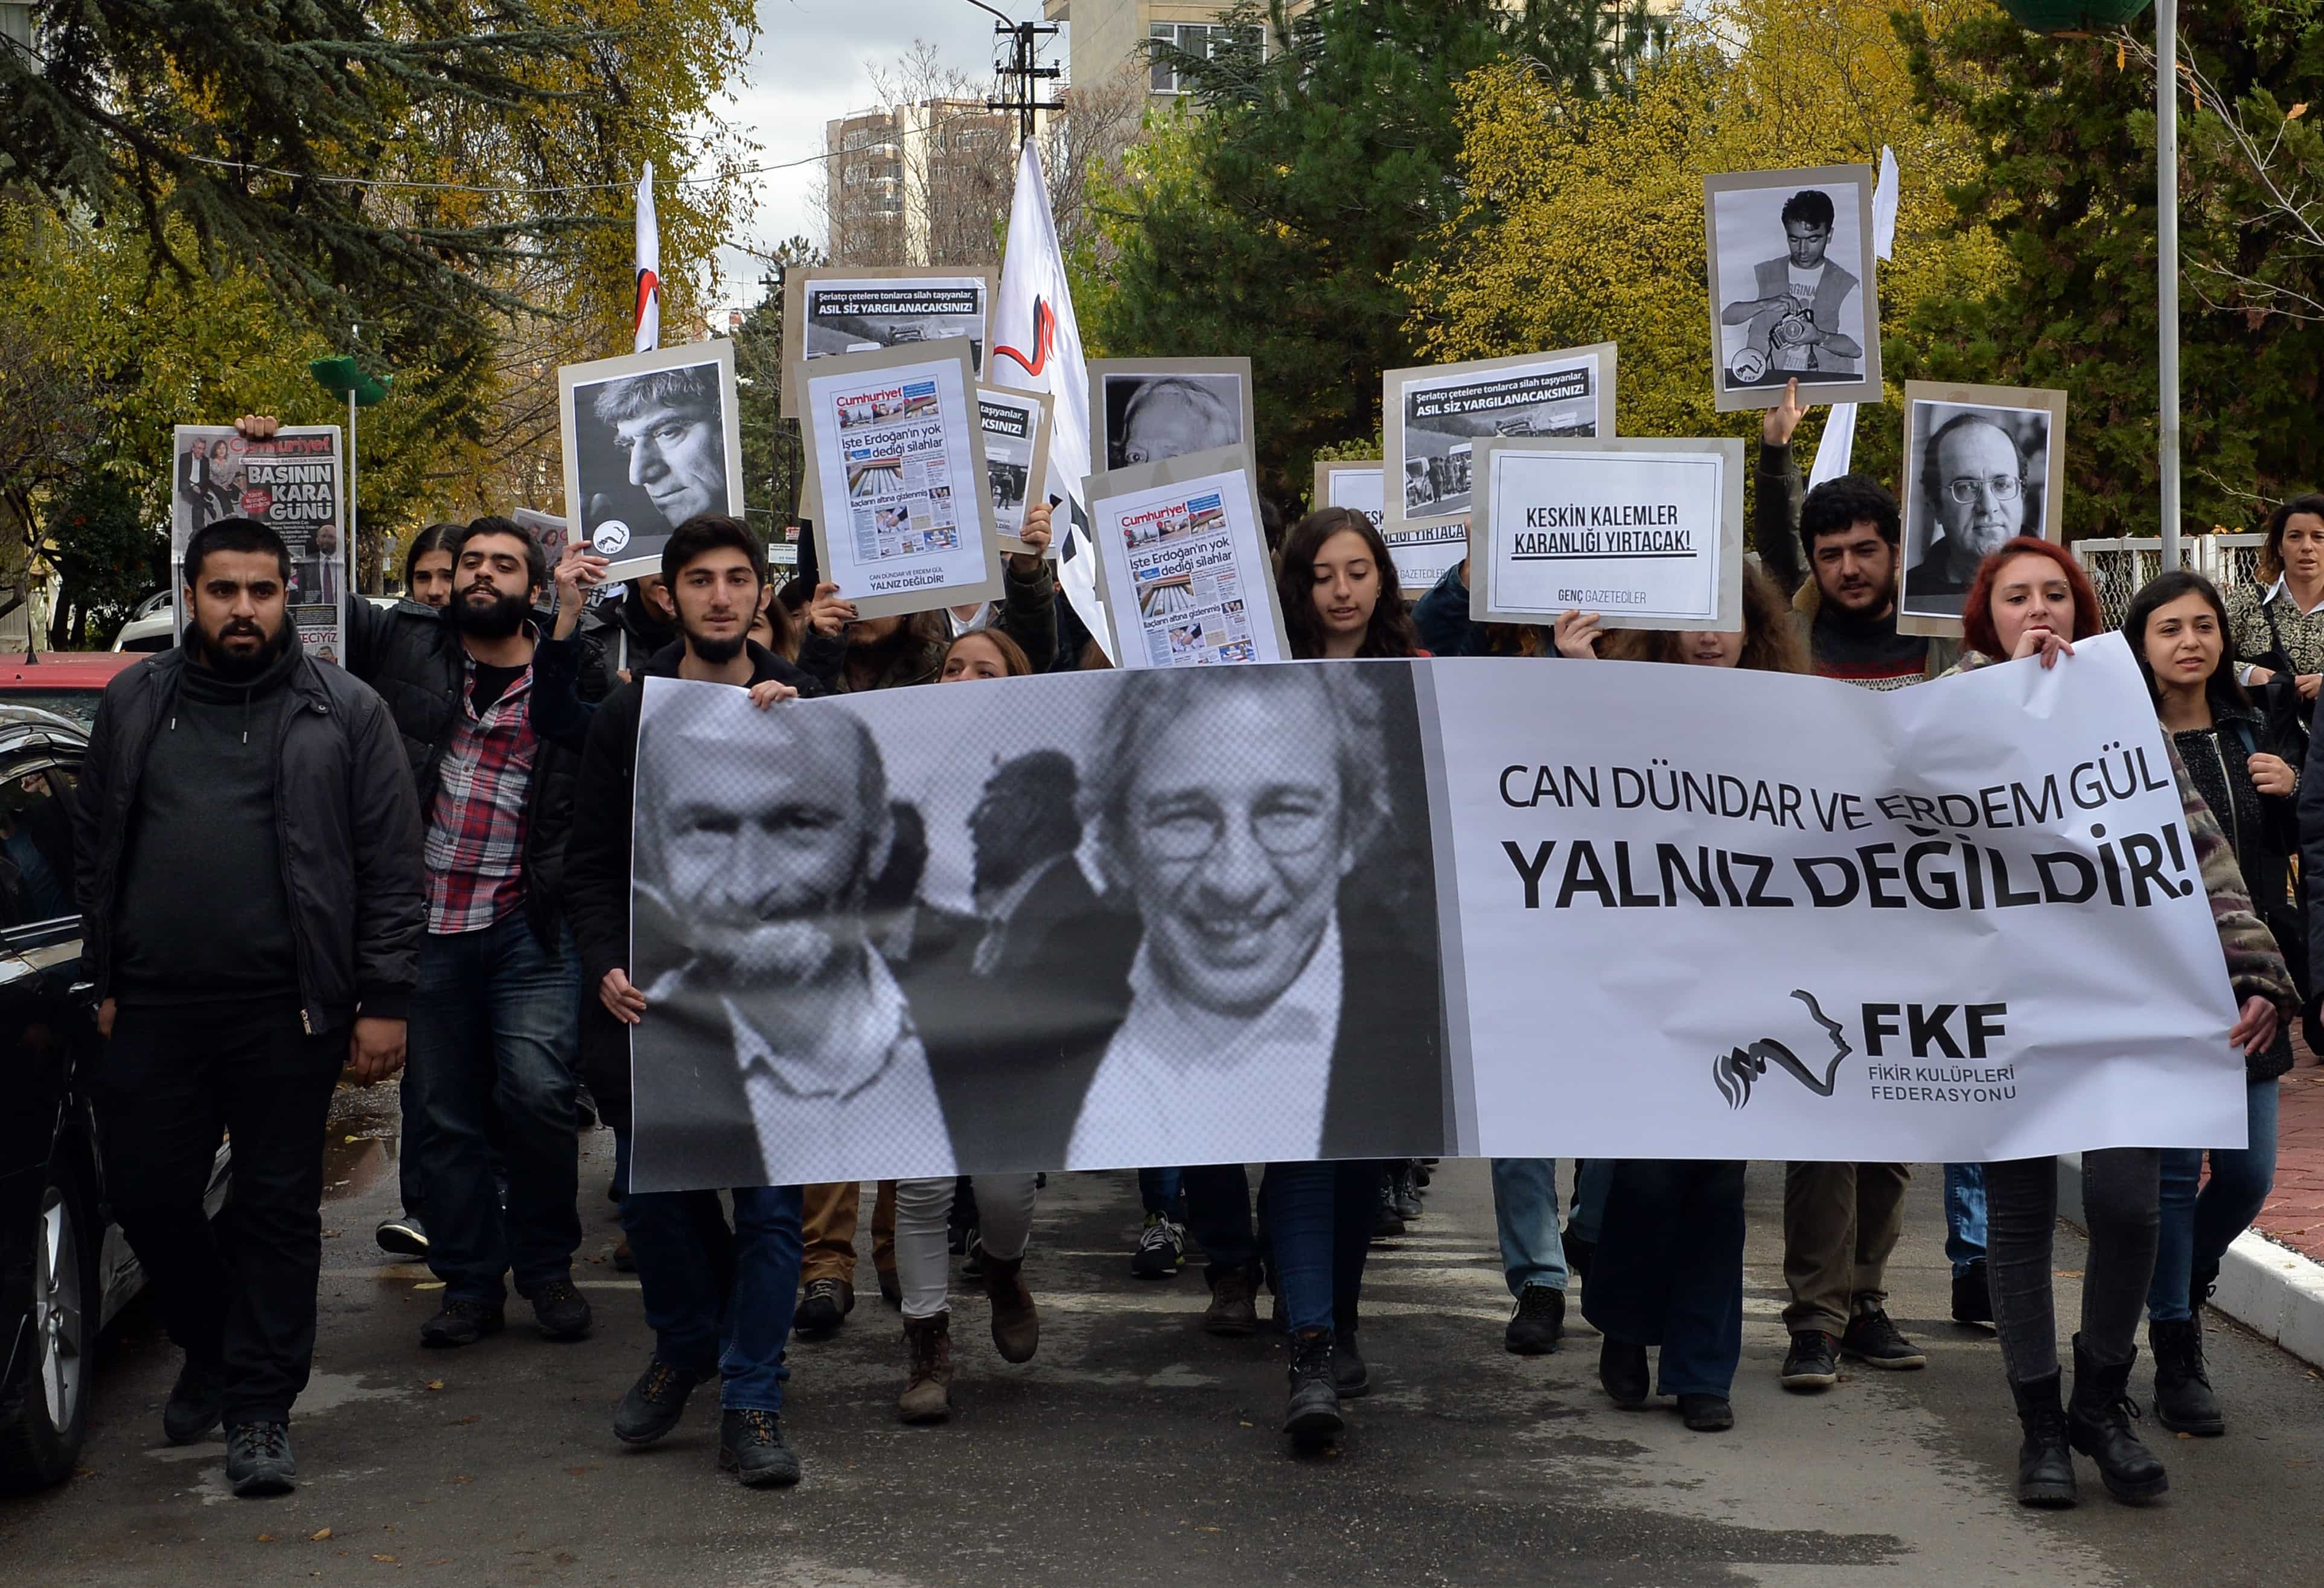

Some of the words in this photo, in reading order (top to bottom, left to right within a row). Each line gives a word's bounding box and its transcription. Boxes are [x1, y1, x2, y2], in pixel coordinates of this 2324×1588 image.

[819, 293, 848, 302] Şeriatçı
[848, 292, 879, 301] çetelere
[913, 291, 931, 299] silah
[933, 290, 974, 301] taşıyanlar,
[819, 304, 841, 314] ASIL
[843, 303, 859, 314] SİZ
[861, 303, 973, 313] YARGILANACAKSINIZ!
[837, 387, 902, 406] Cumhuriyet
[1416, 392, 1448, 404] Şeriatçı
[1449, 388, 1482, 399] çetelere
[1484, 383, 1518, 392] tonlarca
[1519, 379, 1539, 388] silah
[1540, 371, 1585, 386] taşıyanlar,
[1416, 403, 1441, 417] ASIL
[1444, 400, 1461, 414] SİZ
[1463, 383, 1585, 411] YARGILANACAKSINIZ!
[922, 424, 942, 438] yok
[982, 418, 1022, 434] KSINIZ!
[872, 442, 905, 458] dediği
[907, 438, 943, 452] silahlar
[247, 465, 331, 484] BASININ
[272, 484, 332, 502] KARA
[269, 503, 332, 520] GÜNÜ
[1122, 502, 1187, 527] Cumhuriyet
[1527, 503, 1585, 528] KESKİN
[1591, 505, 1678, 527] KALEMLER
[1209, 536, 1230, 552] yok
[1515, 528, 1600, 554] KARANLIĞI
[1606, 530, 1690, 552] YIRTACAK!
[1161, 559, 1194, 575] dediği
[1196, 551, 1232, 568] silahlar
[870, 580, 901, 591] YALNIZ
[902, 574, 944, 587] DEĞİLDİR!
[1559, 589, 1583, 604] GENÇ
[1585, 590, 1647, 604] GAZETECİLER
[1499, 764, 1600, 808] CAN
[1611, 758, 1806, 830] DÜNDAR
[1810, 787, 1873, 833] VE
[1874, 773, 2064, 829] ERDEM
[2069, 740, 2169, 810] GÜL
[1501, 840, 1795, 909] YALNIZ
[1793, 822, 2195, 911] DEĞİLDİR!
[1861, 1002, 2008, 1059] FKF
[1869, 1063, 1912, 1081] FİKİR
[1916, 1064, 2015, 1083] KULÜPLERİ
[1871, 1086, 2017, 1103] FEDERASYONU
